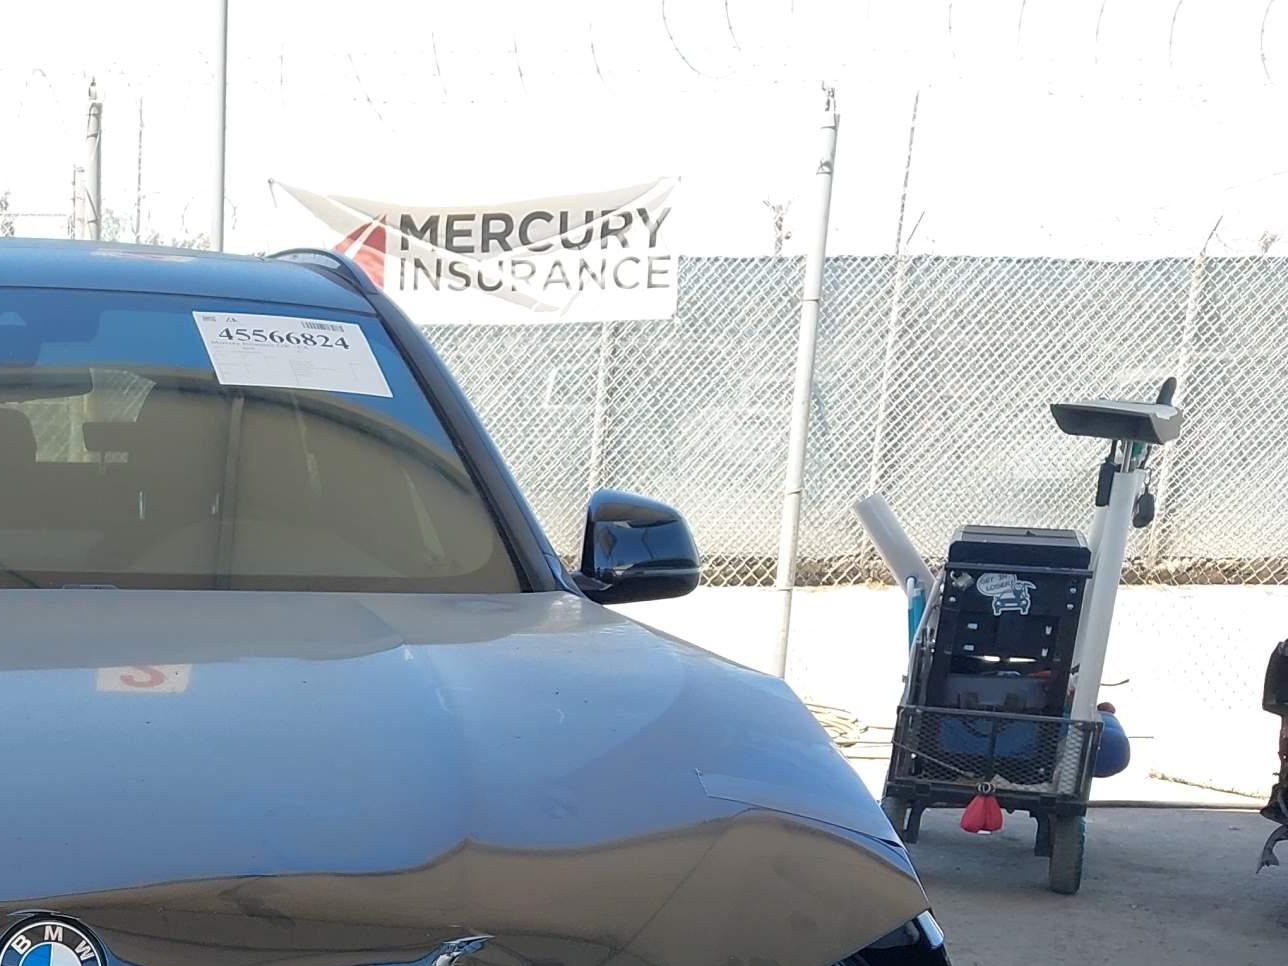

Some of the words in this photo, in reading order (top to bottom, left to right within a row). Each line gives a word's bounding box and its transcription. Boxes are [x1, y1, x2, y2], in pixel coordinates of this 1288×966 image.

[399, 207, 672, 254] MERCURY
[398, 255, 671, 292] INSURANCE
[218, 327, 350, 350] 45566824
[11, 925, 96, 962] BMW
